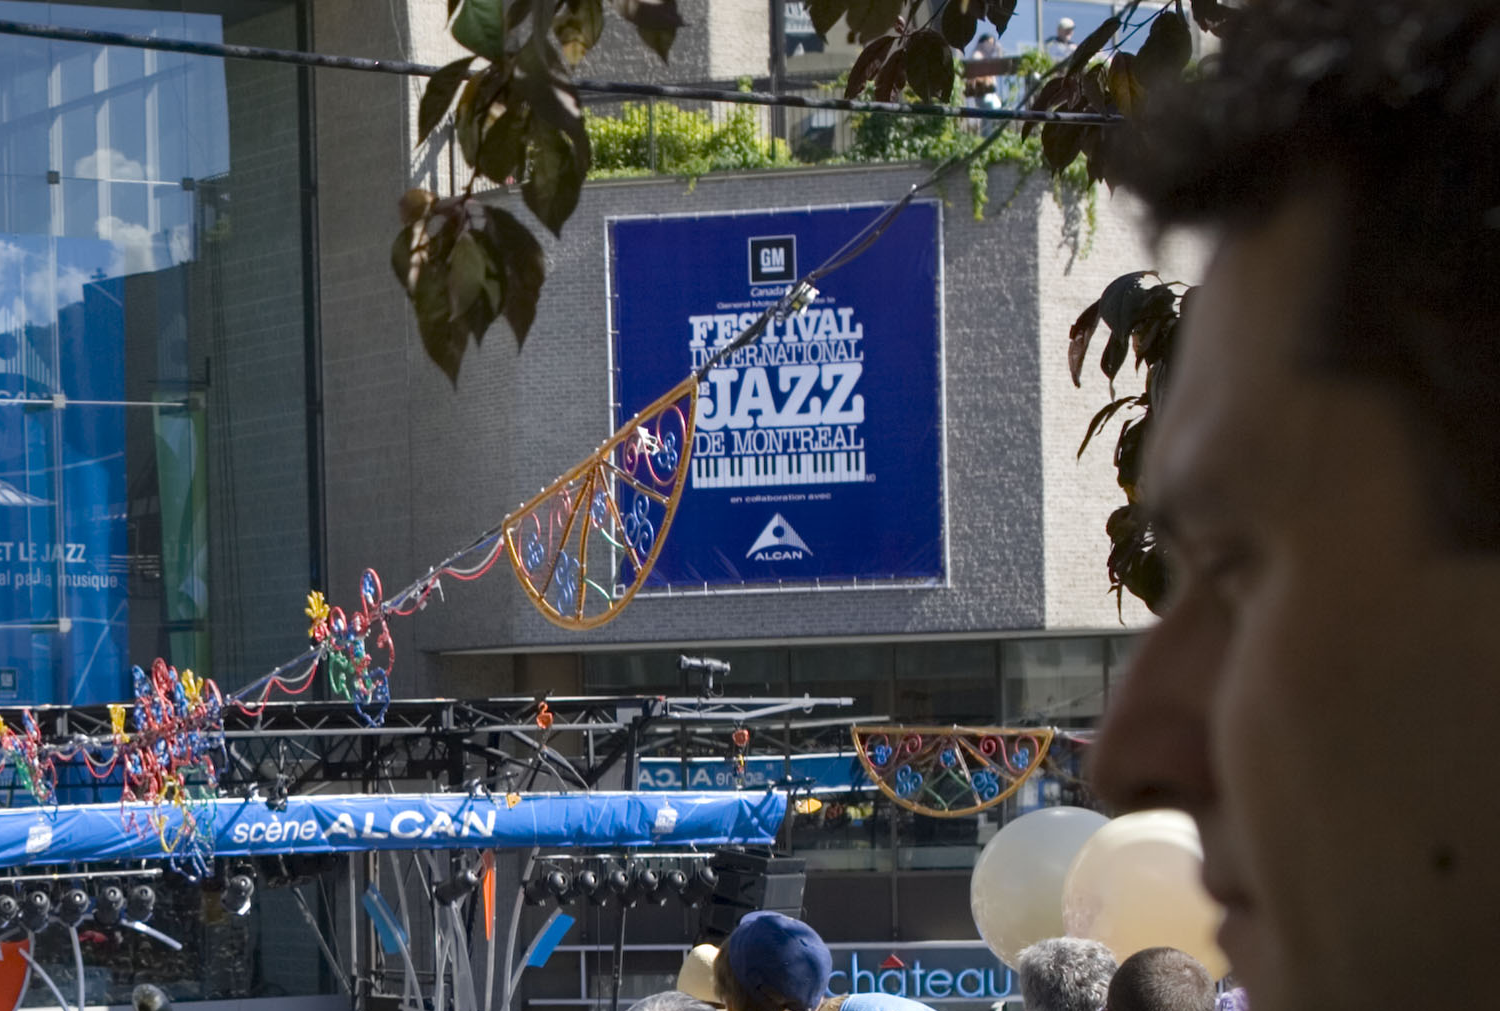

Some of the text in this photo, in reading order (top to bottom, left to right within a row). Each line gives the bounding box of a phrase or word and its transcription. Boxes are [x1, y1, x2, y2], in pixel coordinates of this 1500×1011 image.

[760, 247, 785, 267] GM
[696, 362, 865, 431] JAZZ
[693, 425, 864, 457] DE MONTREAL
[745, 493, 806, 503] collaboration
[808, 492, 832, 501] avec
[19, 541, 37, 562] LE
[40, 543, 87, 563] JAZZ
[754, 550, 803, 561] ALCAN
[60, 572, 119, 591] musique
[232, 809, 496, 843] scène ALCAN
[827, 951, 1013, 998] château
